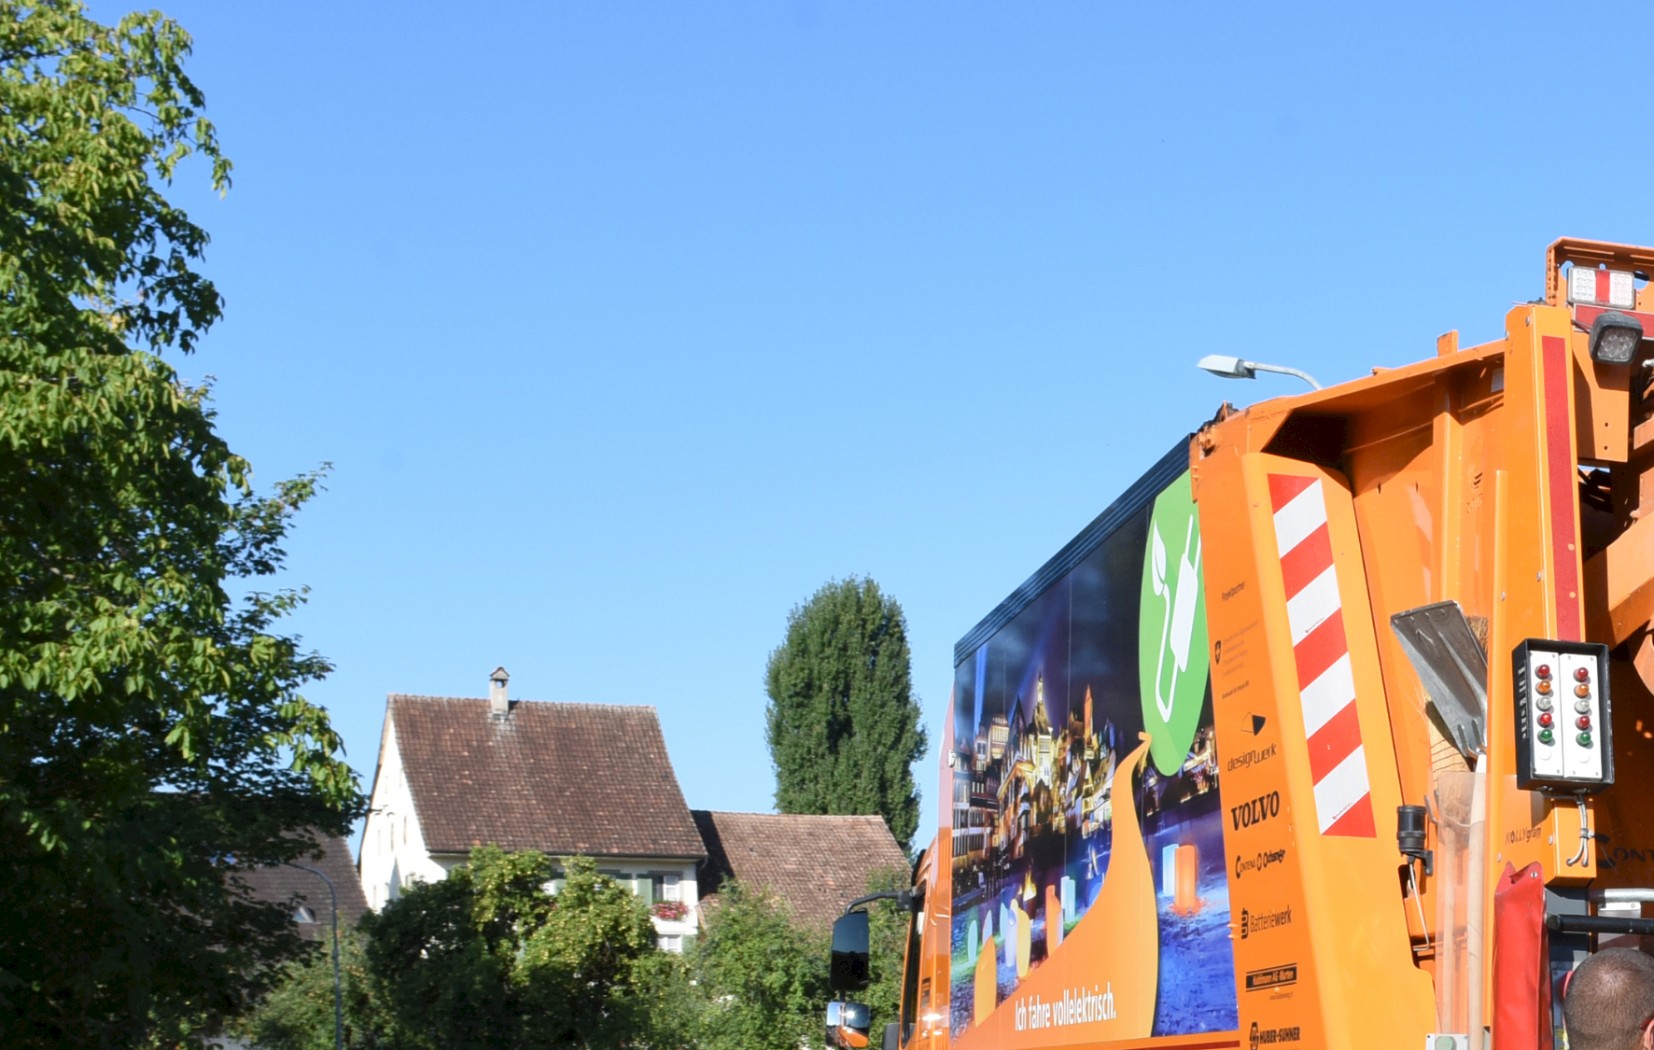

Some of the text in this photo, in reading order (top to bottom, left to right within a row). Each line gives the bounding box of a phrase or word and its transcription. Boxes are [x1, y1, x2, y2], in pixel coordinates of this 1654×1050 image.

[1227, 743, 1277, 772] designwerk
[1231, 790, 1280, 832] VOLVO
[1015, 982, 1117, 1031] Ich fahre vollelektrisch.
